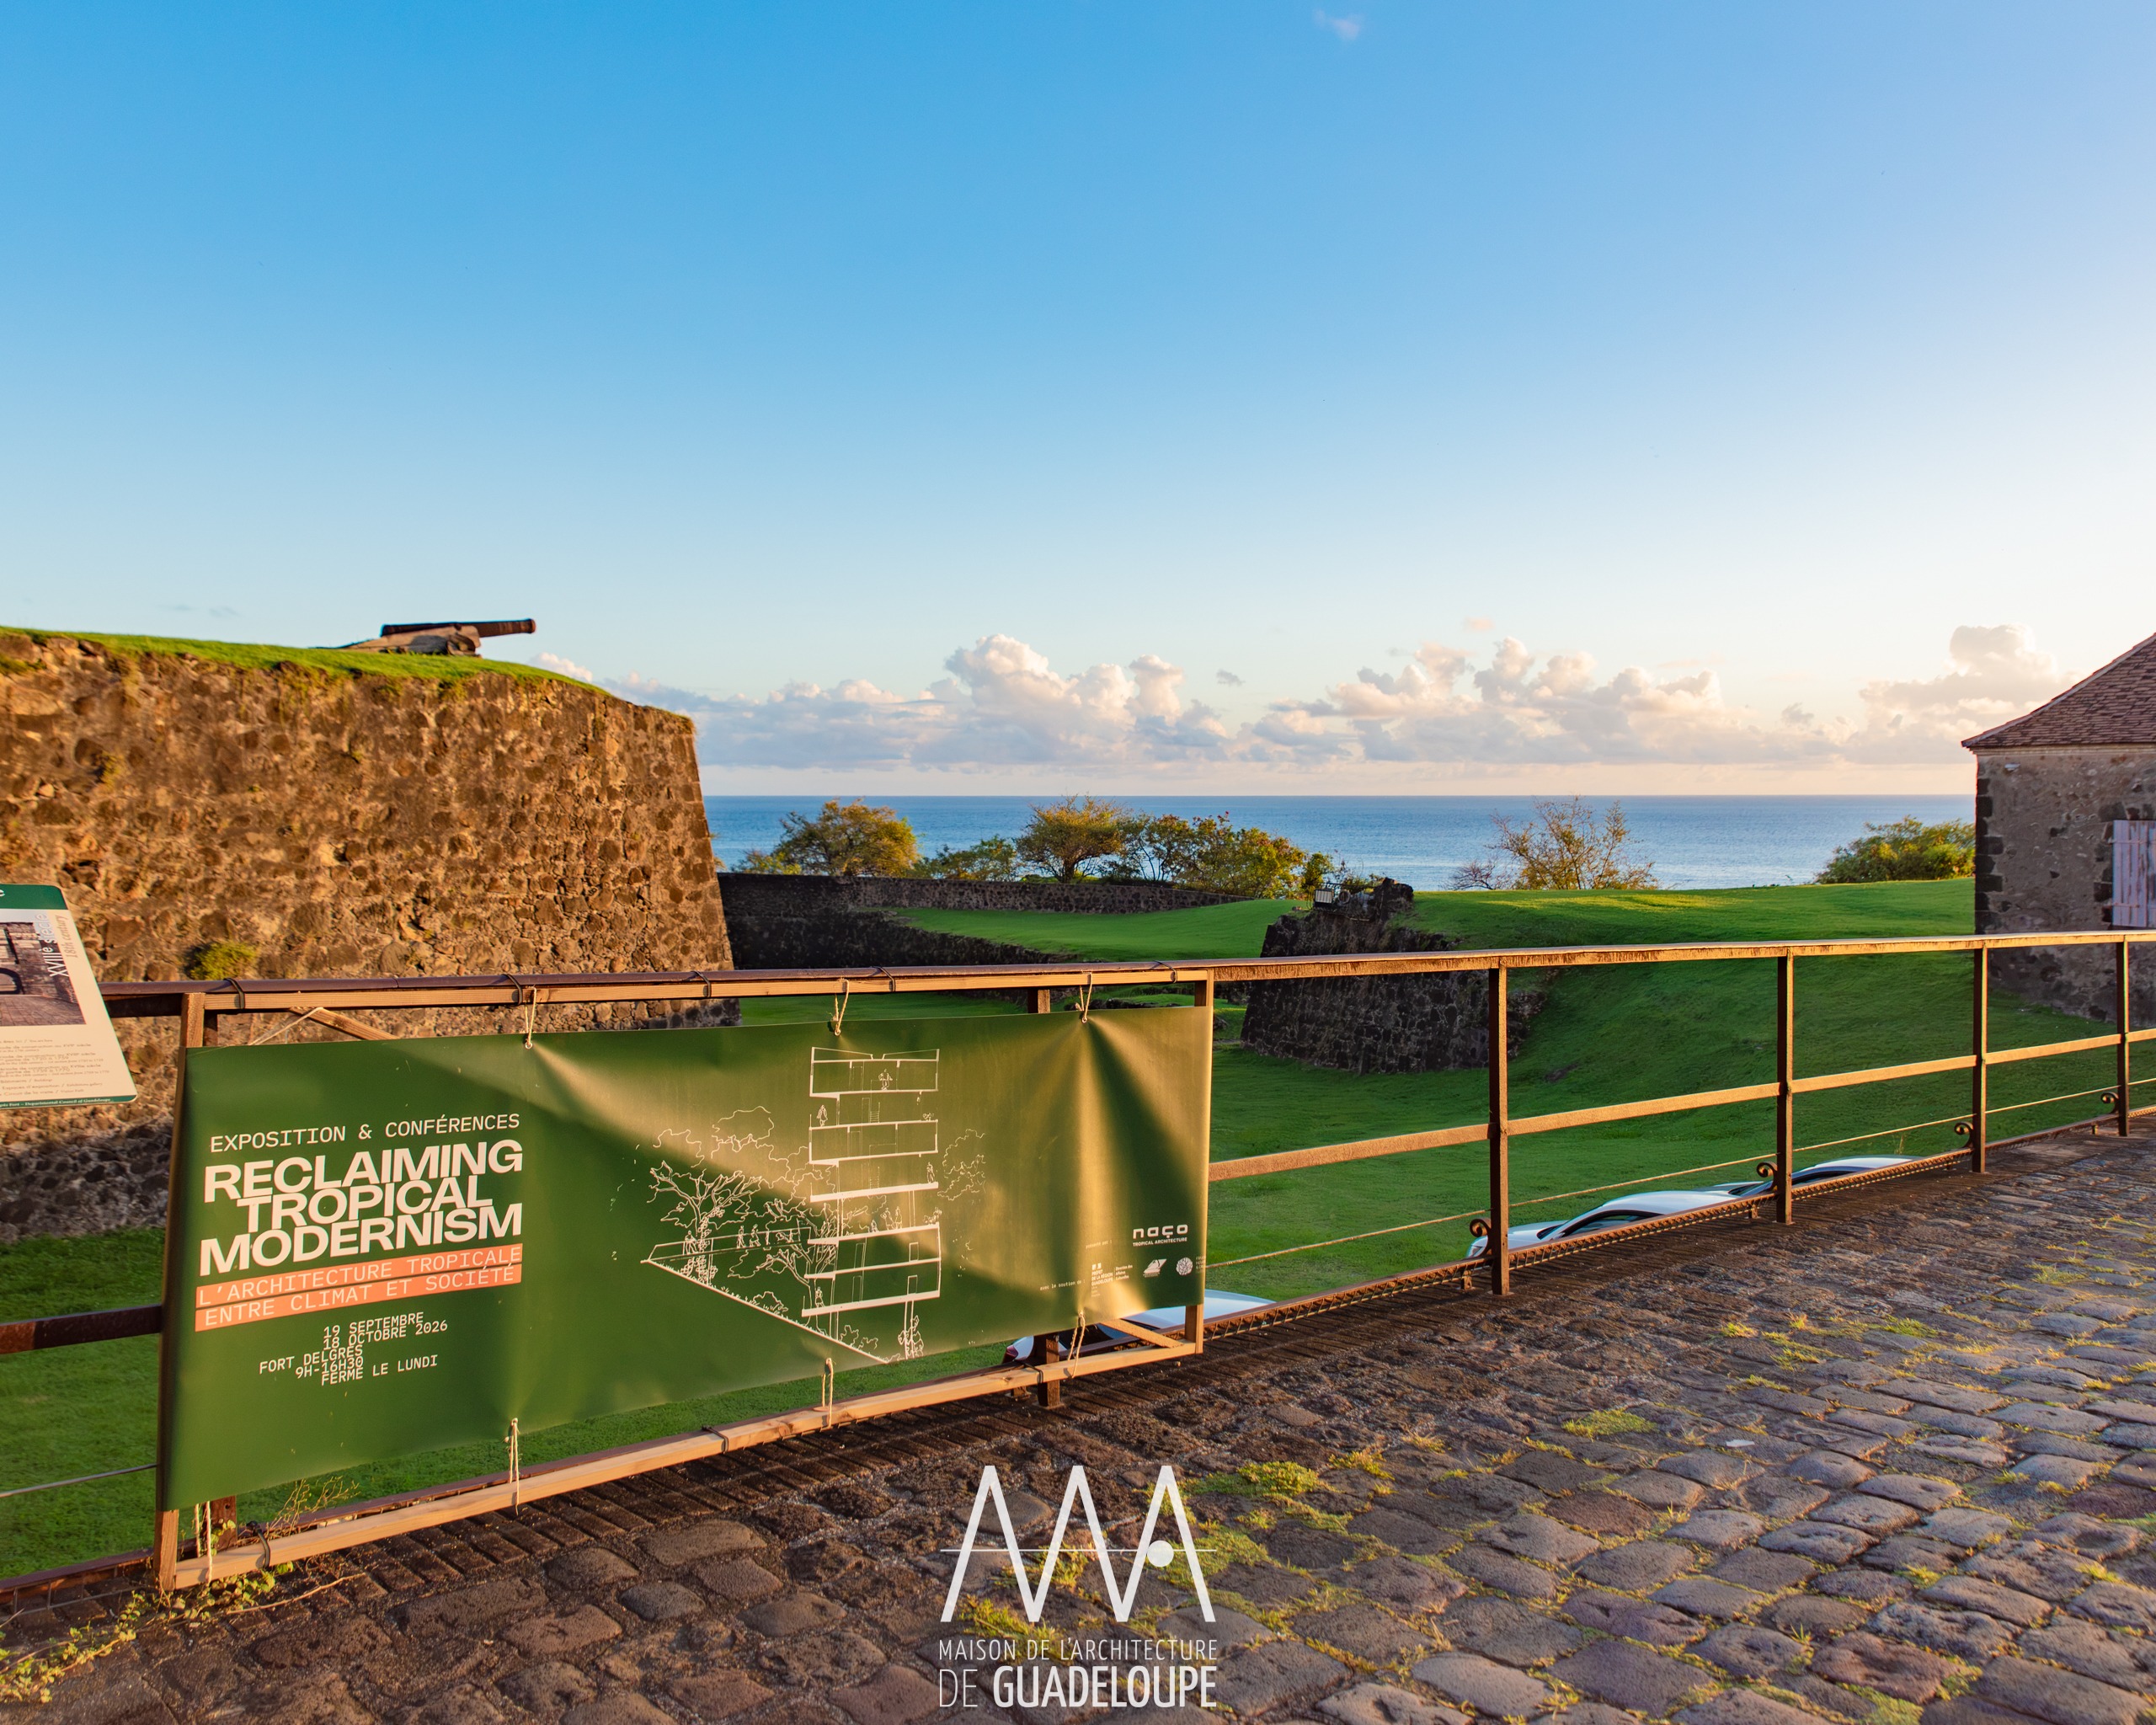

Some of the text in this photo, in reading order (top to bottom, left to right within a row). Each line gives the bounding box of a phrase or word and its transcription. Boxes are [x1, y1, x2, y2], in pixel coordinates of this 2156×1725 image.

[210, 1113, 520, 1153] EXPOSITION & CONFÉRENCES
[204, 1139, 523, 1203] RECLAIMING
[236, 1175, 493, 1233] TROPICAL
[200, 1203, 522, 1277] MODERNISM
[1133, 1224, 1188, 1239] naço
[1155, 1236, 1187, 1245] ARCHITECTURE
[199, 1247, 521, 1306] L'ARCHITECTURE TROPICALE
[1091, 1277, 1113, 1286] GUADELOUPE
[205, 1263, 515, 1327] ENTRE CLIMAT ET SOCIÉTÉ
[323, 1311, 424, 1339] 19 SEPTEMBRE
[323, 1319, 448, 1351] 18 OCTOBRE 2026
[259, 1355, 295, 1375] FORT
[295, 1355, 364, 1379] 9H-16H30
[372, 1362, 389, 1377] LE
[398, 1354, 439, 1373] LUNDI
